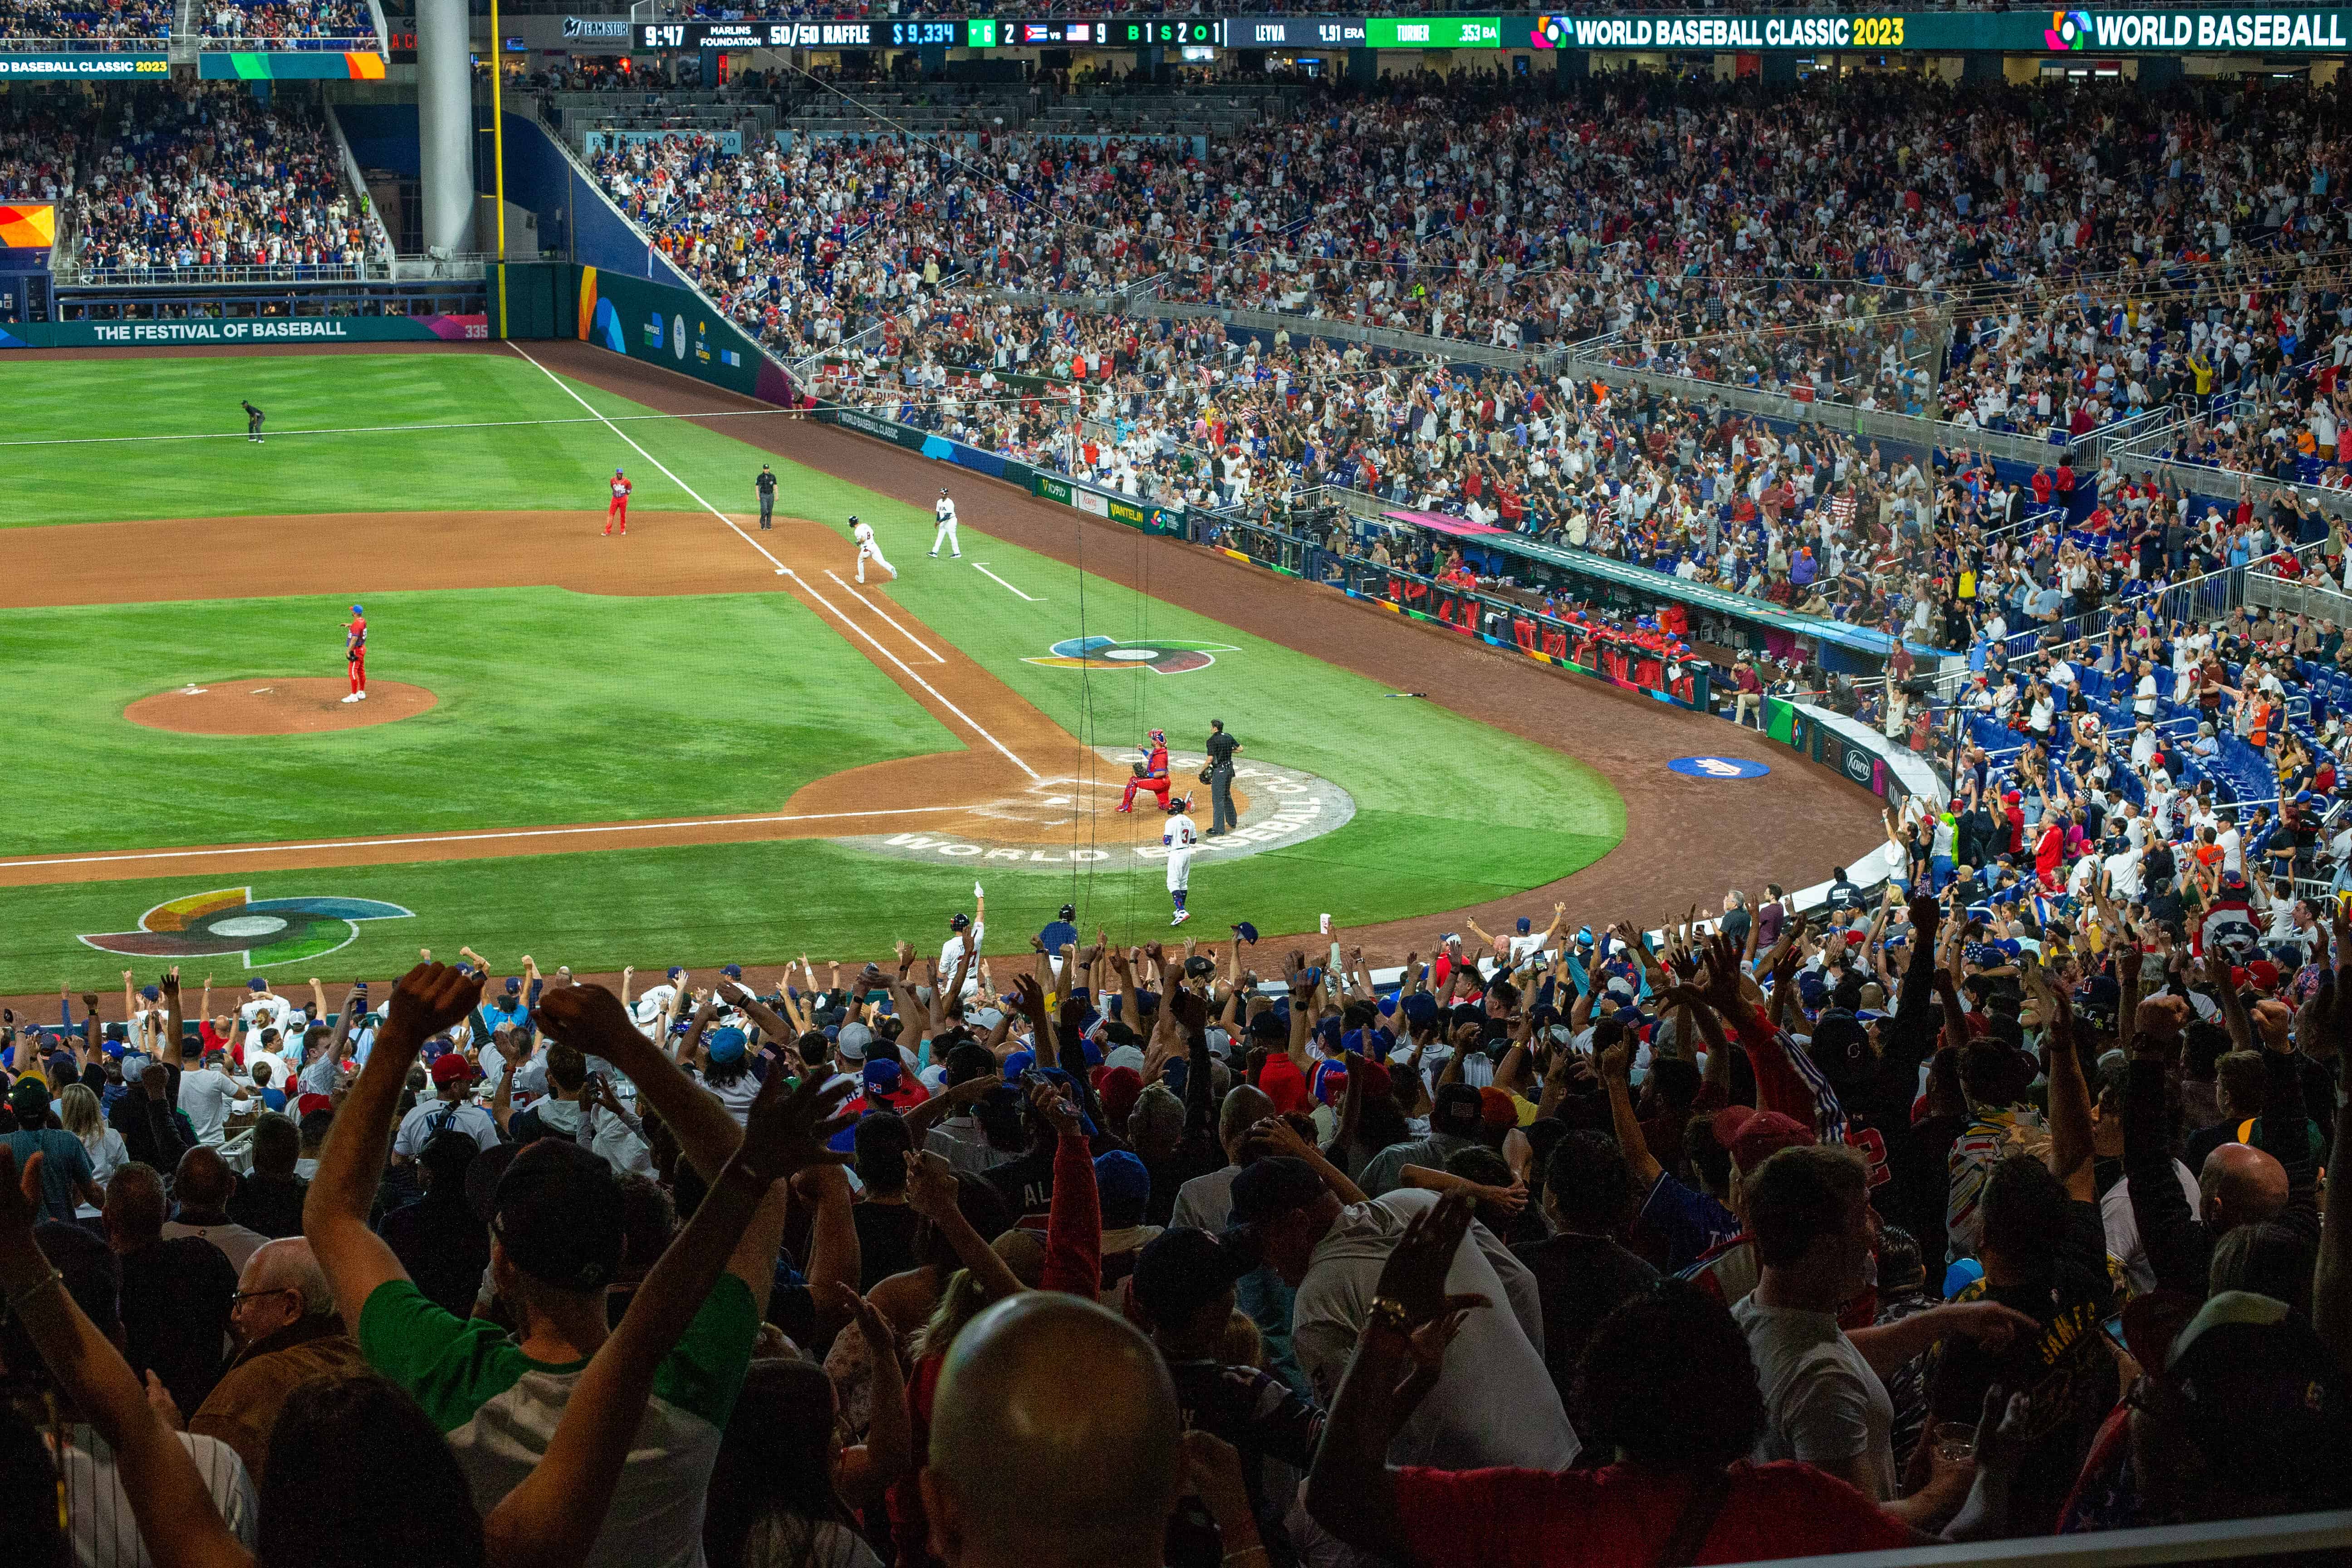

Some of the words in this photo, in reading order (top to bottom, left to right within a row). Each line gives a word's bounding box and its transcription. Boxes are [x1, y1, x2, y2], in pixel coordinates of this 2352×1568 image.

[582, 22, 604, 36] TEAM
[606, 22, 628, 36] STOR
[646, 26, 683, 46] 9:47
[710, 26, 751, 35] MARLINS
[771, 23, 819, 47] 50/50
[823, 25, 870, 44] RAFFLE
[908, 24, 953, 44] 9,334
[984, 25, 991, 43] 6
[1005, 24, 1014, 44] 2
[1050, 31, 1061, 39] vs
[1097, 23, 1106, 43] 9
[1128, 26, 1139, 39] B
[1146, 23, 1152, 43] 1
[1161, 25, 1171, 39] S
[1178, 23, 1186, 43] 2
[1194, 26, 1206, 40] O
[1214, 23, 1219, 43] 1
[1255, 25, 1285, 41] LEYVA
[1319, 24, 1340, 41] 4.91
[1344, 27, 1365, 38] ERA
[1397, 24, 1430, 41] TURNER
[1459, 24, 1480, 41] .353
[1482, 27, 1497, 38] BA
[1576, 21, 1652, 45] WORLD
[1656, 20, 1763, 45] BASEBALL
[1766, 19, 1849, 45] CLASSIC
[1853, 18, 1904, 45] 2023
[2097, 15, 2192, 46] WORLD
[2198, 15, 2346, 46] BASEBALL
[701, 38, 761, 46] FOUNDATION
[11, 62, 78, 72] BASEBALL
[79, 62, 134, 72] CLASSIC
[136, 61, 167, 72] 2023
[94, 326, 131, 340] THE
[134, 324, 220, 339] FESTIVAL
[223, 323, 248, 338] OF
[252, 322, 346, 337] BASEBALL
[465, 325, 488, 338] 335
[842, 412, 857, 426] WORLD
[857, 416, 879, 432] BASEBALL
[879, 424, 898, 439] CLASSIC
[1110, 503, 1143, 523] VANTELIN
[1848, 753, 1869, 776] Kowa
[1182, 828, 1189, 843] 3
[884, 833, 1110, 862] WORLD
[958, 951, 977, 968] 7
[251, 1008, 273, 1017] TUR
